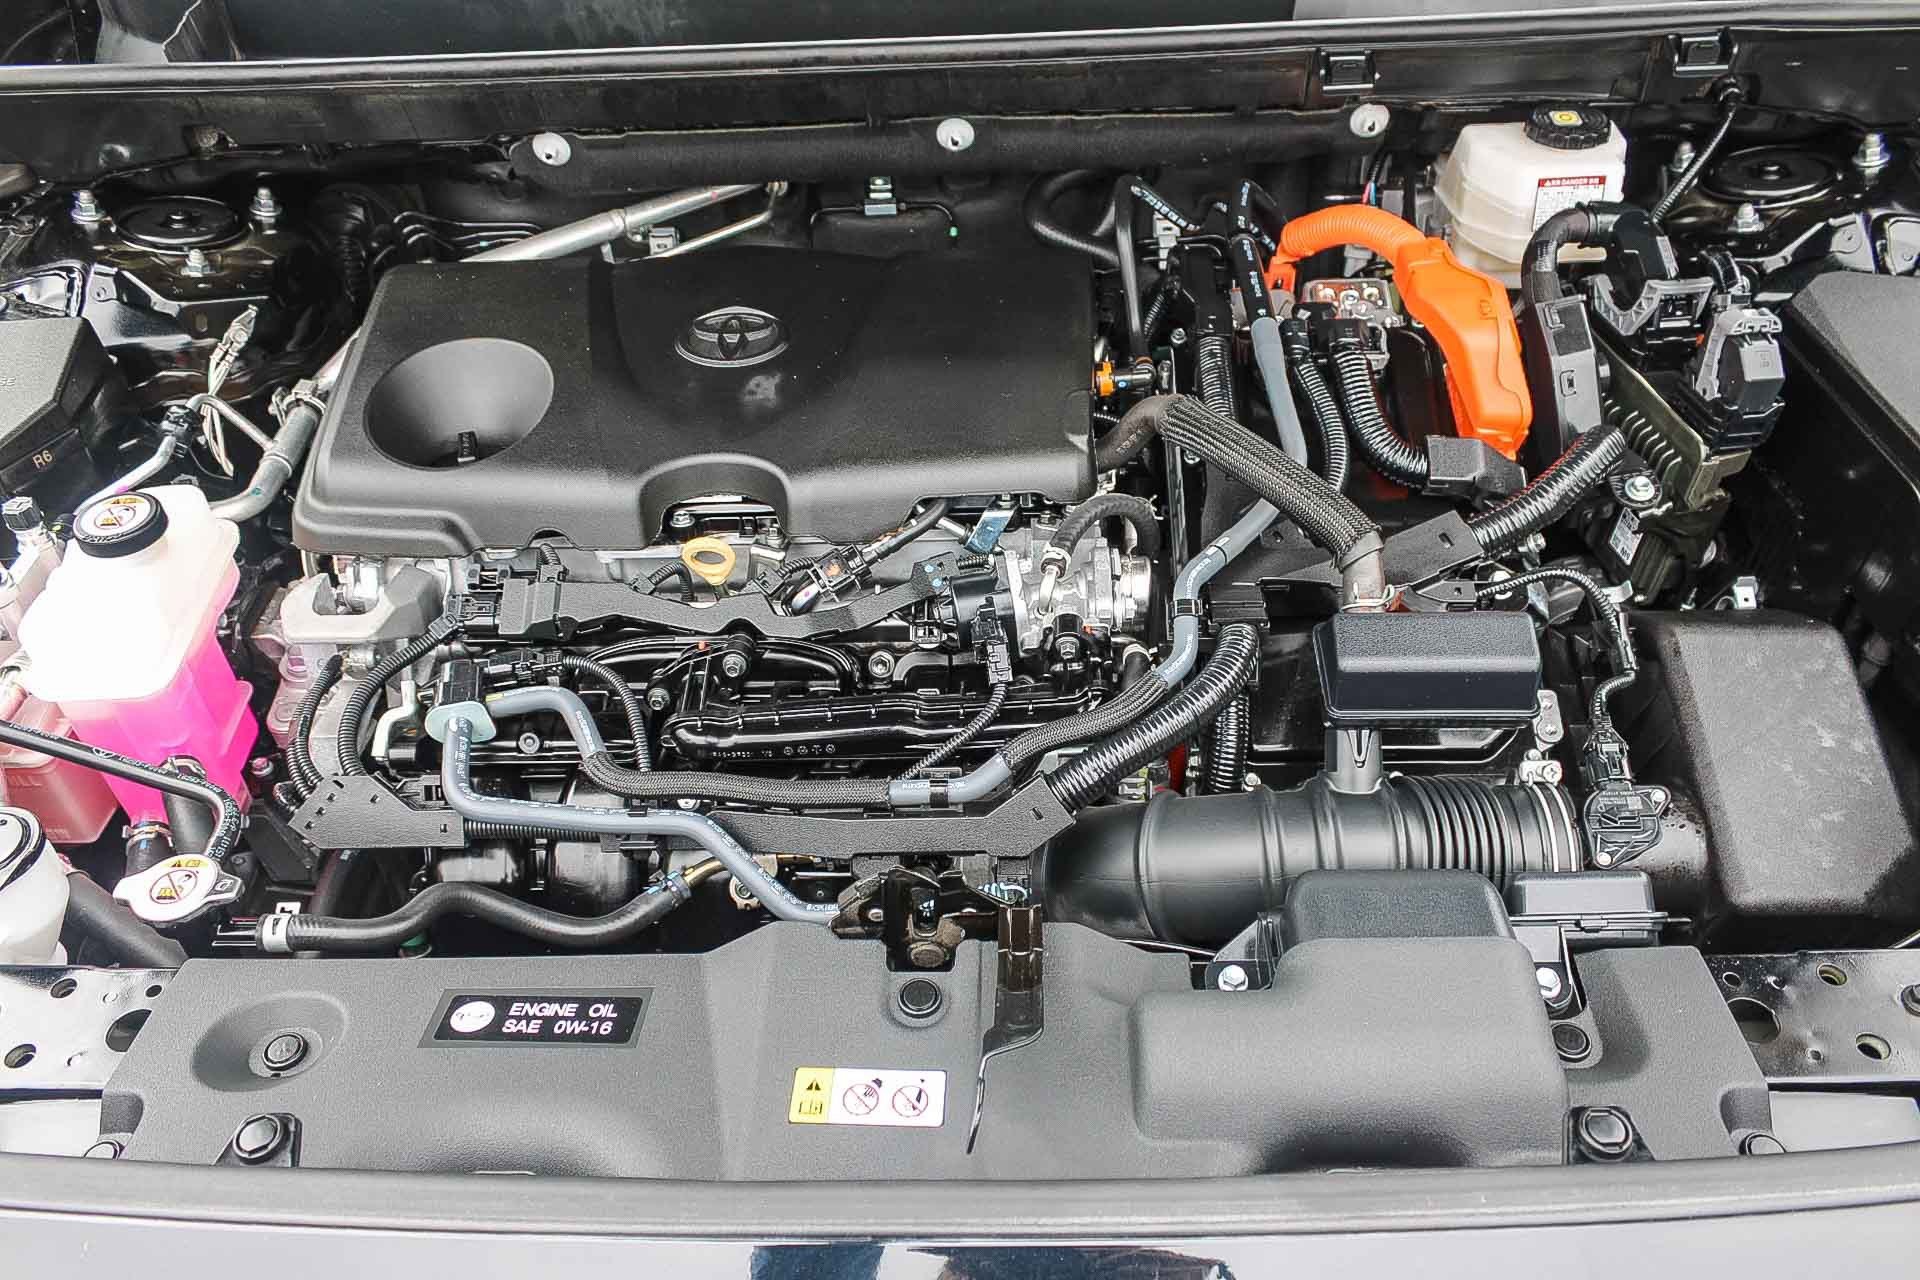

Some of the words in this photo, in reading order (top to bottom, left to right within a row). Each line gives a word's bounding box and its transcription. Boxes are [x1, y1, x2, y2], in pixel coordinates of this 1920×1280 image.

[33, 450, 53, 469] R6
[508, 1003, 579, 1017] ENGINE
[588, 1003, 618, 1018] OIL
[502, 1019, 543, 1034] SAE
[553, 1020, 614, 1035] 0W-16
